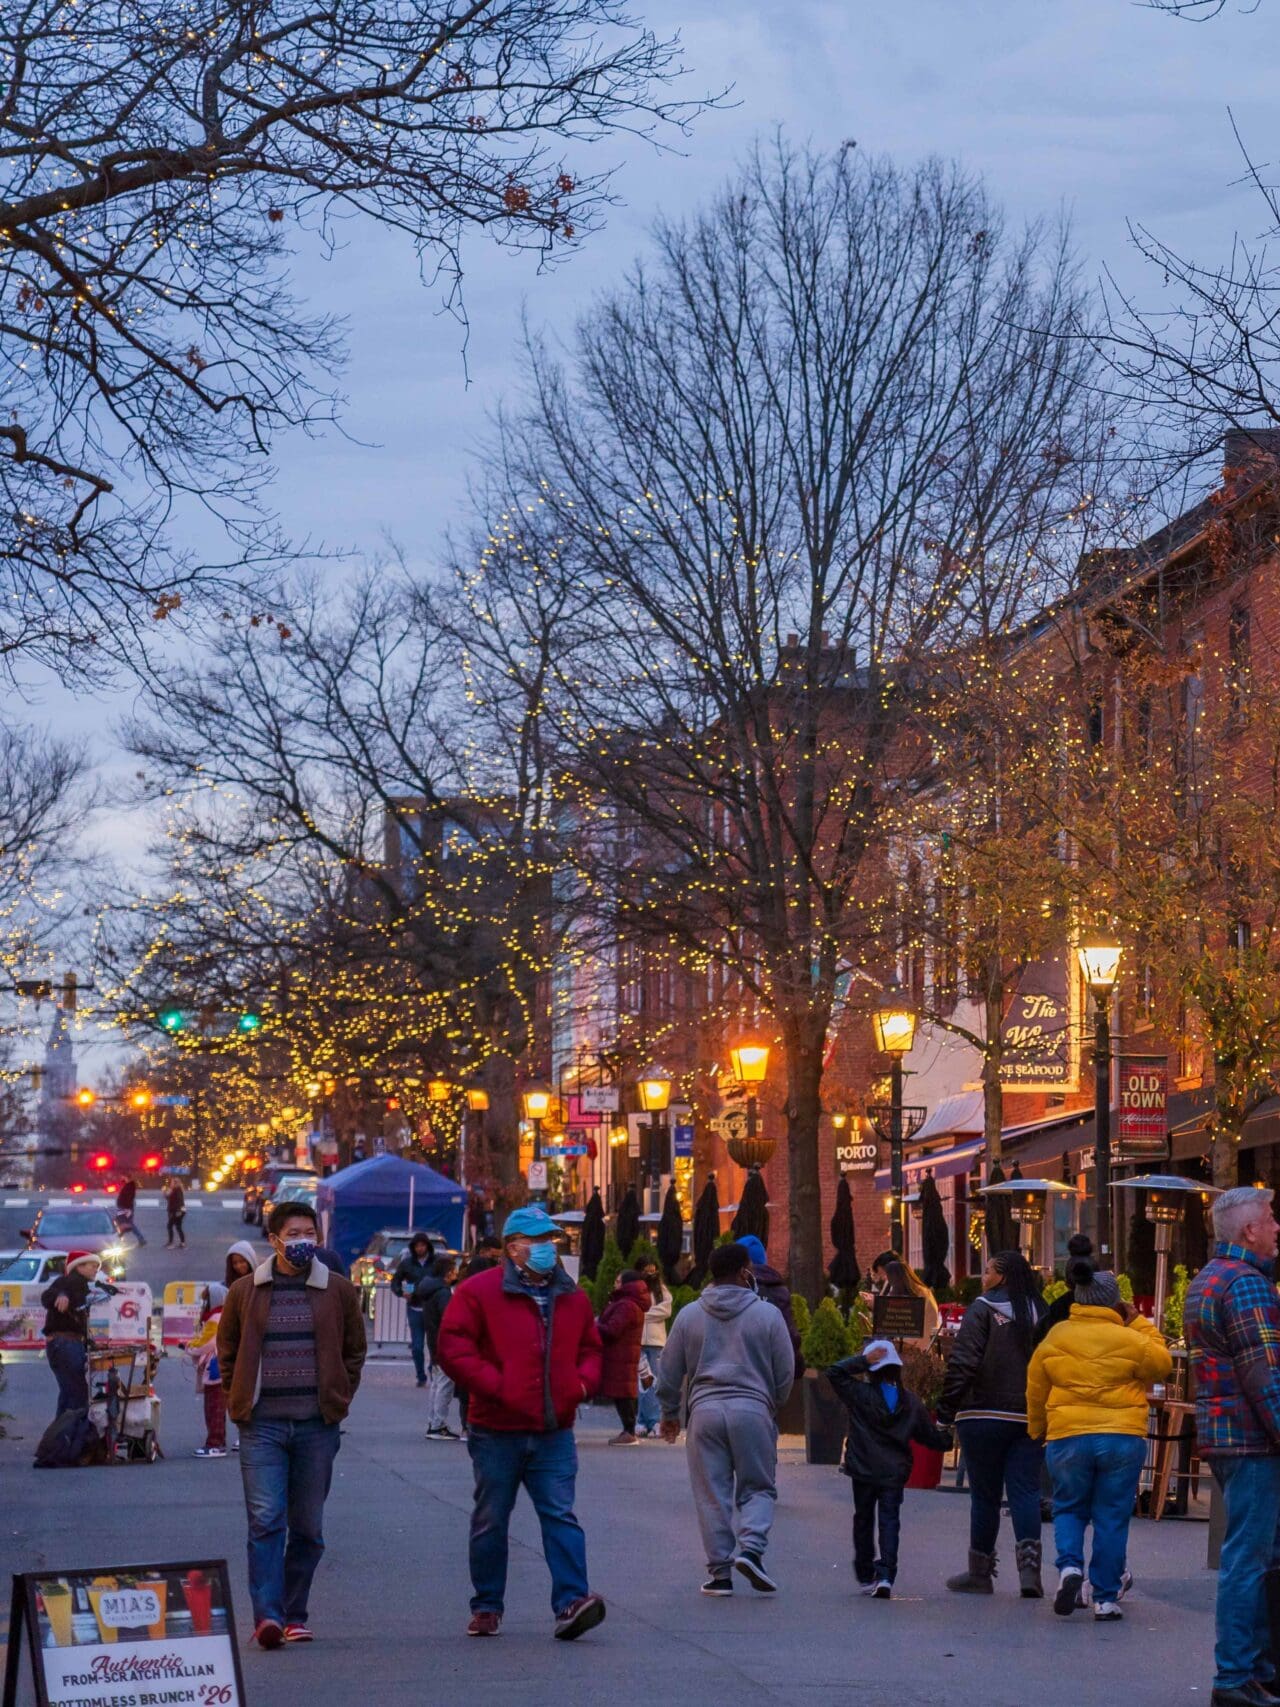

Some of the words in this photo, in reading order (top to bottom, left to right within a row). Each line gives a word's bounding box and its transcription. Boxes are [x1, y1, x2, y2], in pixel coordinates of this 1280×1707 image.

[1022, 995, 1057, 1019] The
[1015, 1064, 1064, 1076] SEAFOOD
[1129, 1075, 1160, 1092] OLD
[1121, 1091, 1166, 1108] TOWN
[836, 1145, 877, 1160] PORTO
[104, 1596, 156, 1614] MIA'S
[91, 1653, 184, 1675] Authentic
[62, 1668, 161, 1687] FROM-SCRATCH
[164, 1664, 215, 1680] ITALIAN
[140, 1689, 195, 1706] BRUNCH
[198, 1684, 233, 1706] $26
